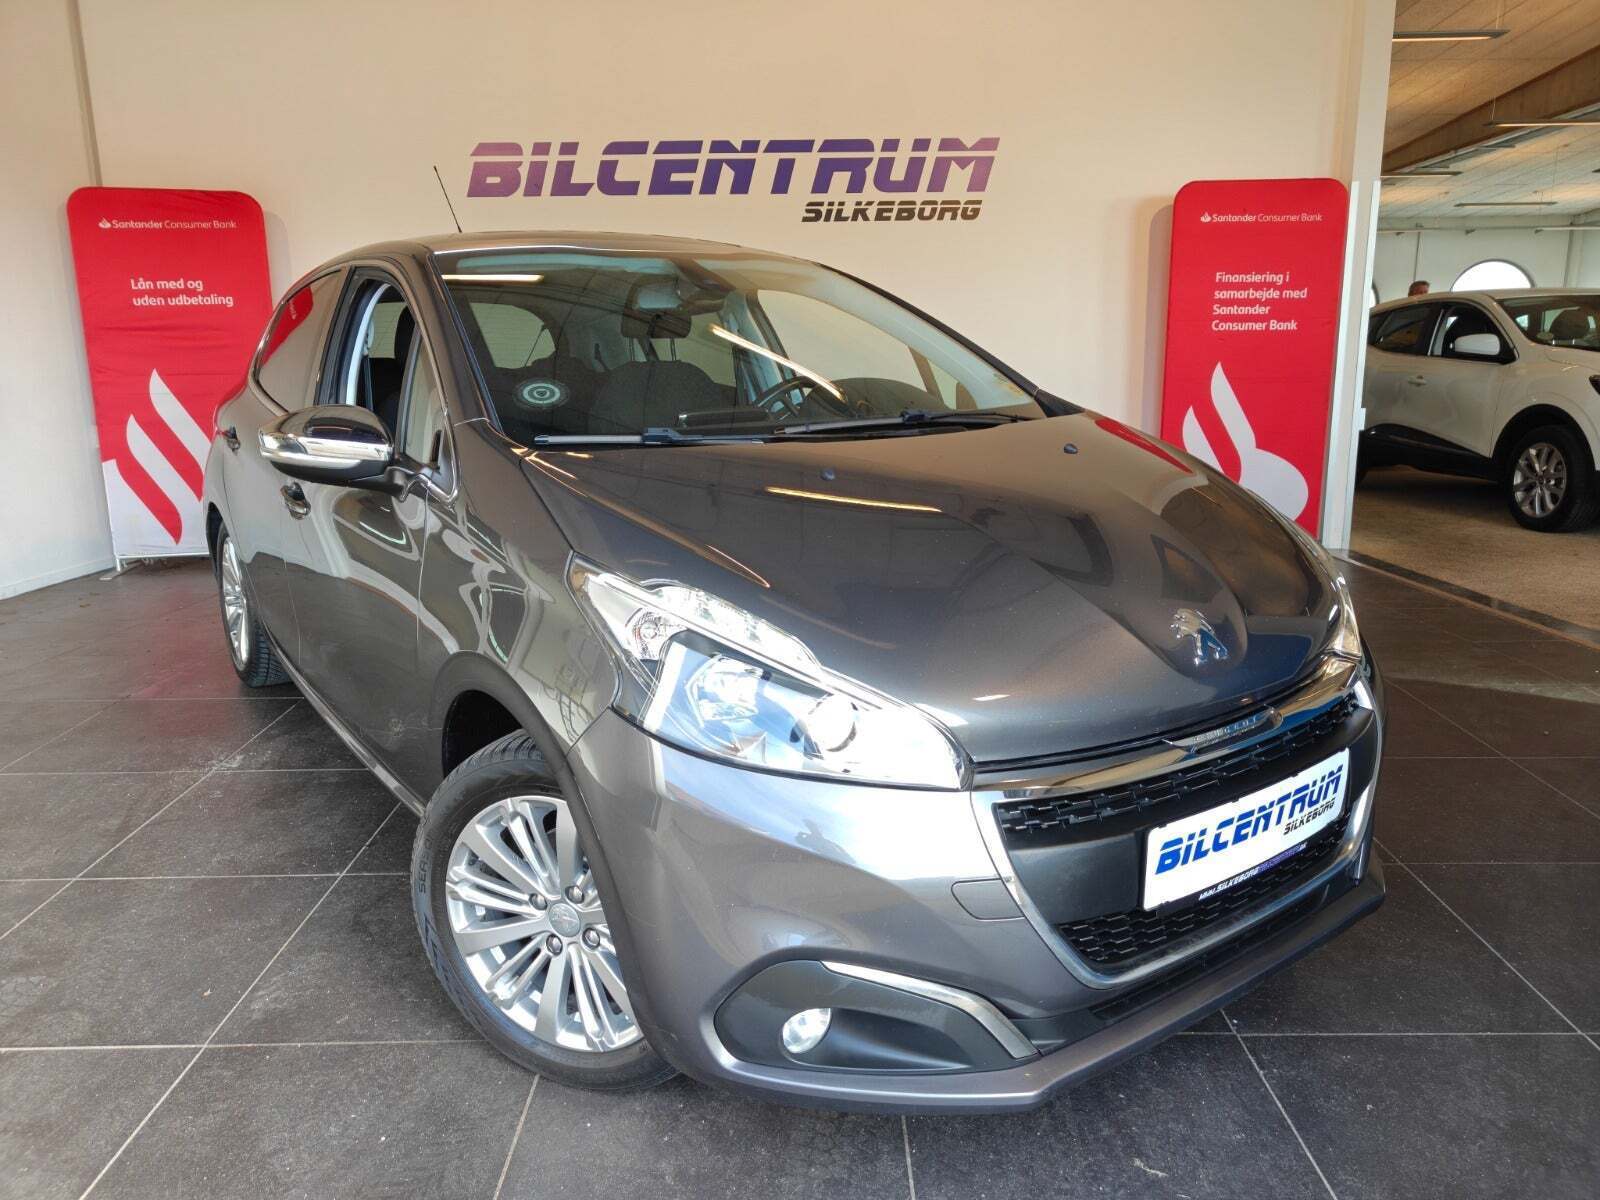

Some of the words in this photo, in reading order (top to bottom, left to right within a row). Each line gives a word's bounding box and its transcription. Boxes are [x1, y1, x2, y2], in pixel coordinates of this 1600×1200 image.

[466, 137, 1001, 198] BILCENTRUM
[801, 199, 983, 223] SILKEBORG
[1212, 213, 1257, 223] Santander
[1257, 213, 1301, 222] Consumer
[1301, 212, 1323, 222] Bank
[112, 219, 163, 229] Santander
[164, 220, 213, 229] Consumer
[213, 220, 237, 229] Bank
[130, 277, 154, 290] Lån
[156, 278, 185, 290] med
[187, 280, 204, 292] og
[1215, 271, 1284, 285] Finansiering
[1286, 272, 1290, 282] i
[132, 295, 165, 306] uden
[167, 293, 234, 307] udbetaling
[1214, 287, 1281, 301] samarbejde
[1282, 287, 1308, 299] med
[1212, 303, 1271, 315] Santander
[1211, 319, 1268, 331] Consumer
[1269, 319, 1298, 331] Bank
[1155, 763, 1344, 875] BILCENTRUM
[1283, 796, 1336, 836] SILKEBORG
